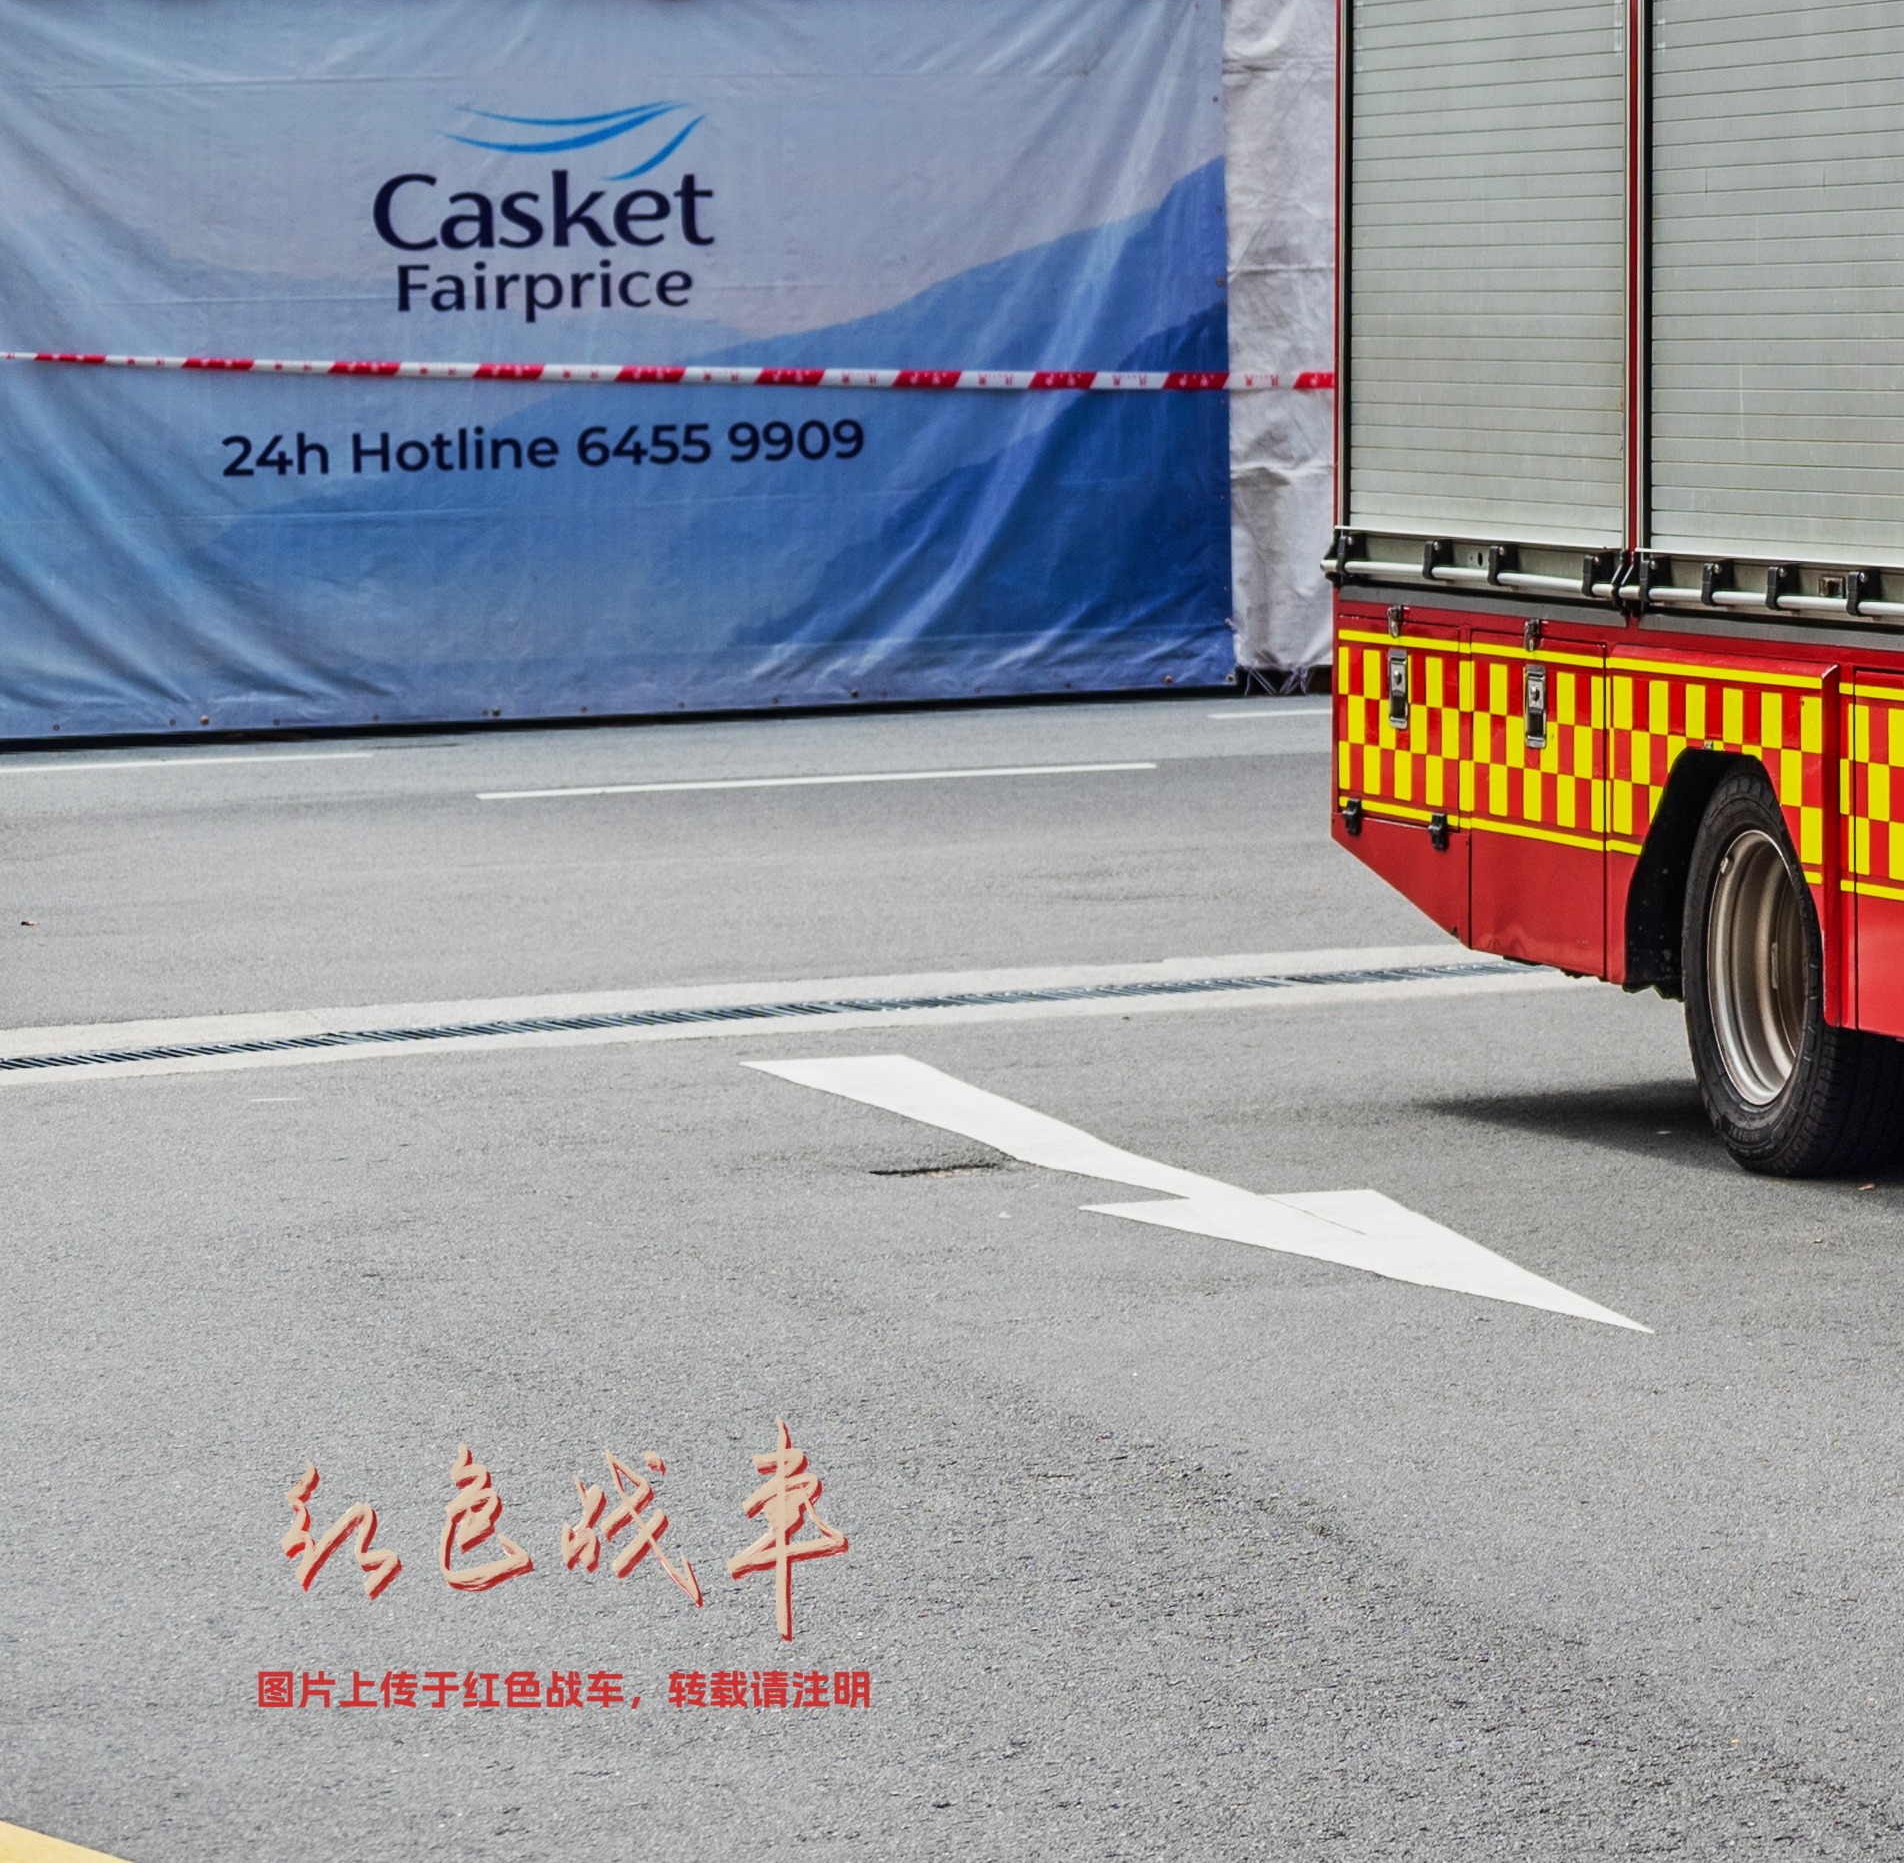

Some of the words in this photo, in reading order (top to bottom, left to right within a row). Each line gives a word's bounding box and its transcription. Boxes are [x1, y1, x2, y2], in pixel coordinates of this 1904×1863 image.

[373, 169, 715, 251] Casket
[397, 259, 693, 323] Fairprice
[222, 432, 329, 477] 24h
[352, 426, 559, 473] Hotline
[577, 423, 712, 467] 6455
[728, 419, 865, 463] 9909
